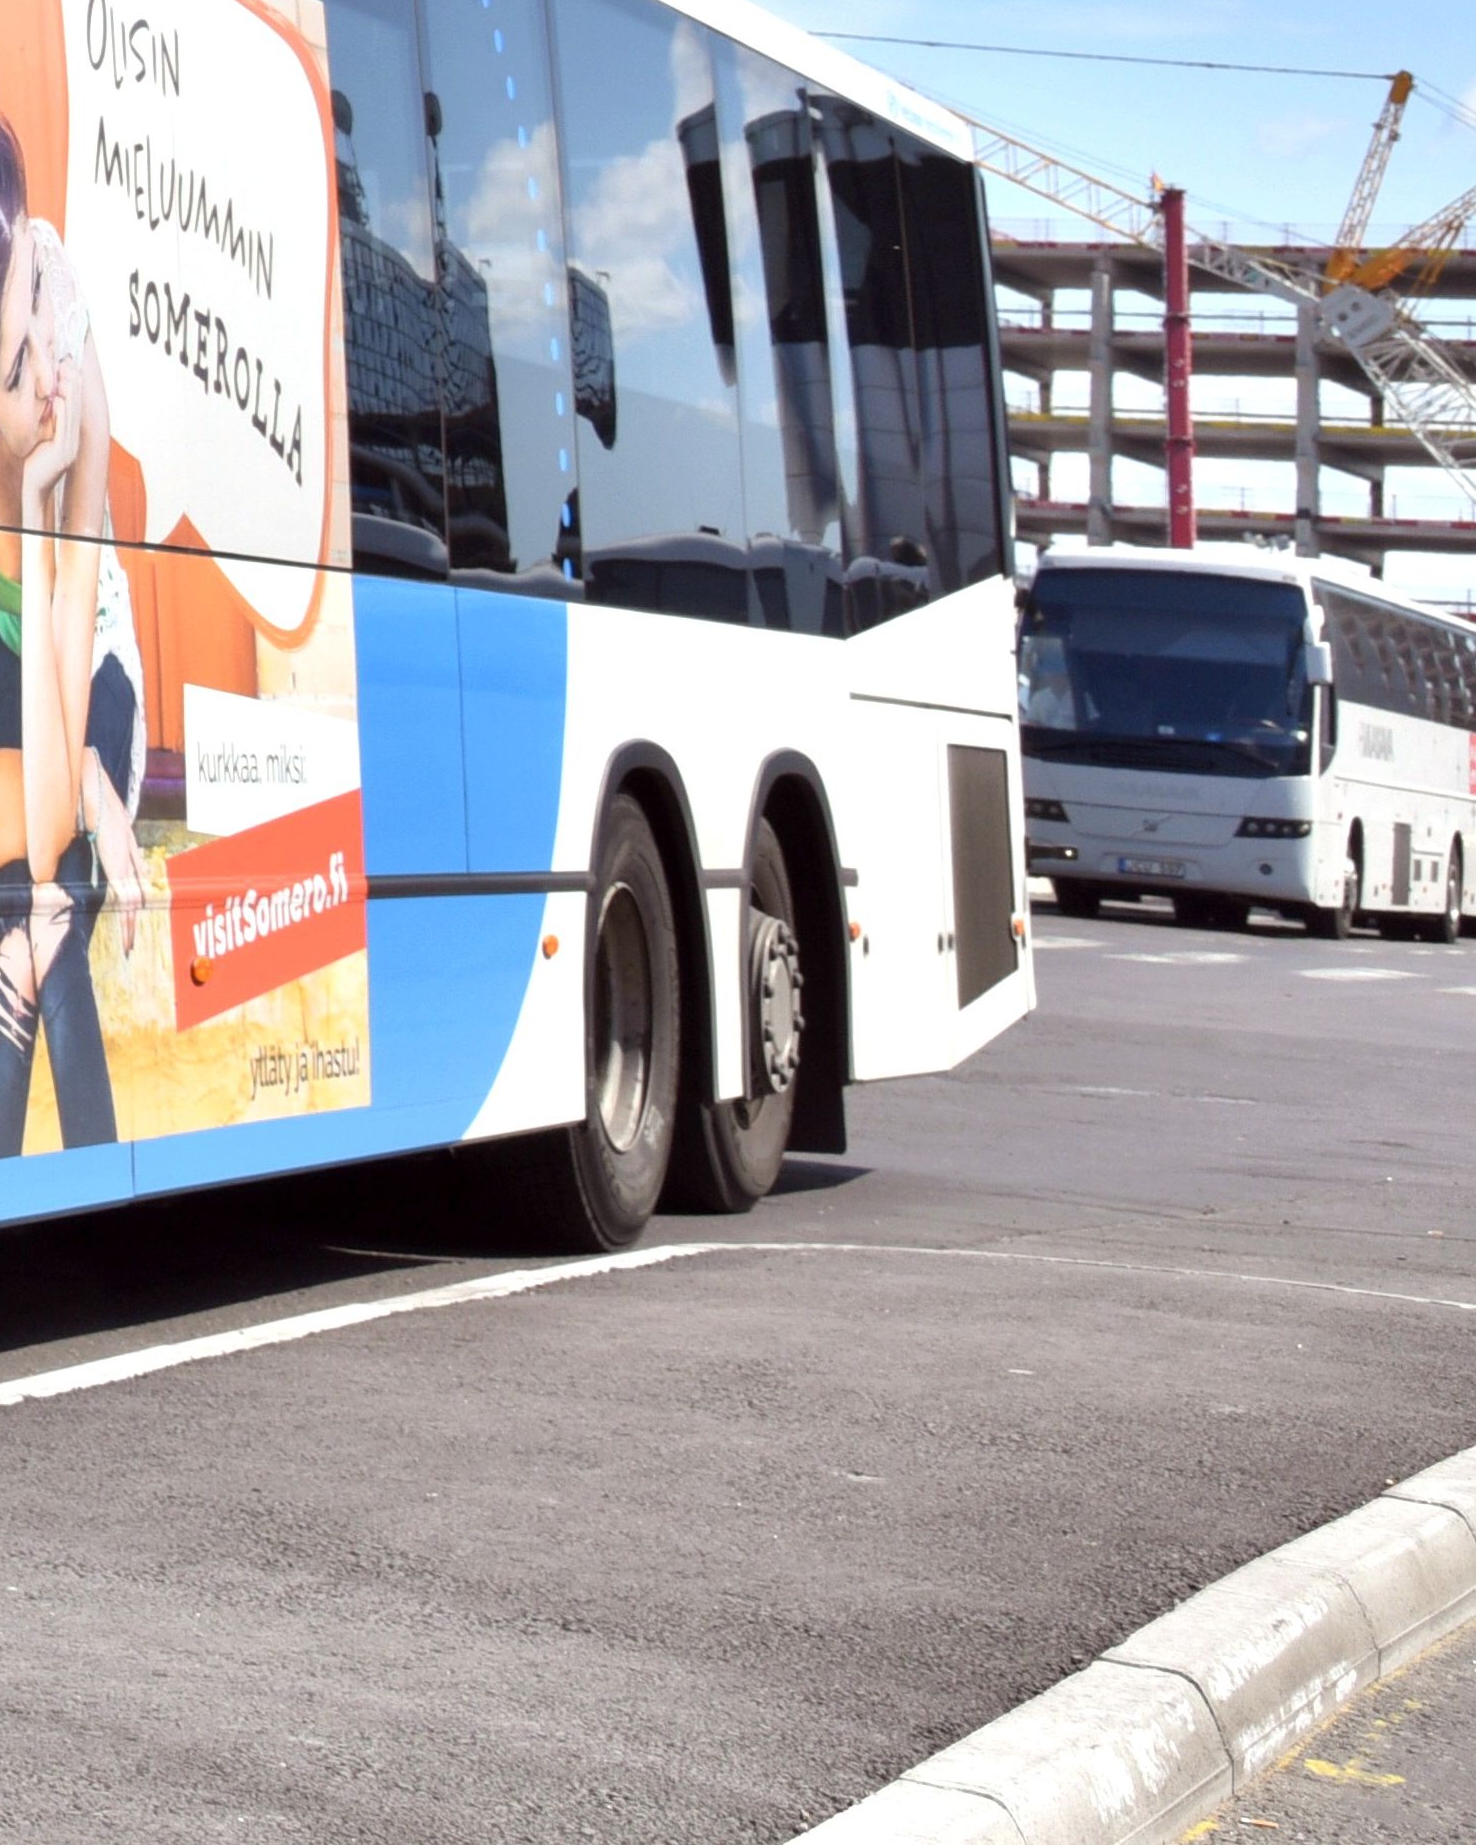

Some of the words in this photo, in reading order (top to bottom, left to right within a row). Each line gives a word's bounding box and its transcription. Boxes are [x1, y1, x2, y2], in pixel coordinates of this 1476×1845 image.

[94, 116, 273, 301] MIELUUMMIN
[129, 267, 304, 487] SOMEROLLA
[192, 850, 349, 960] visitSomero.fi
[294, 1041, 310, 1093] ja
[311, 1036, 361, 1087] ihastu!
